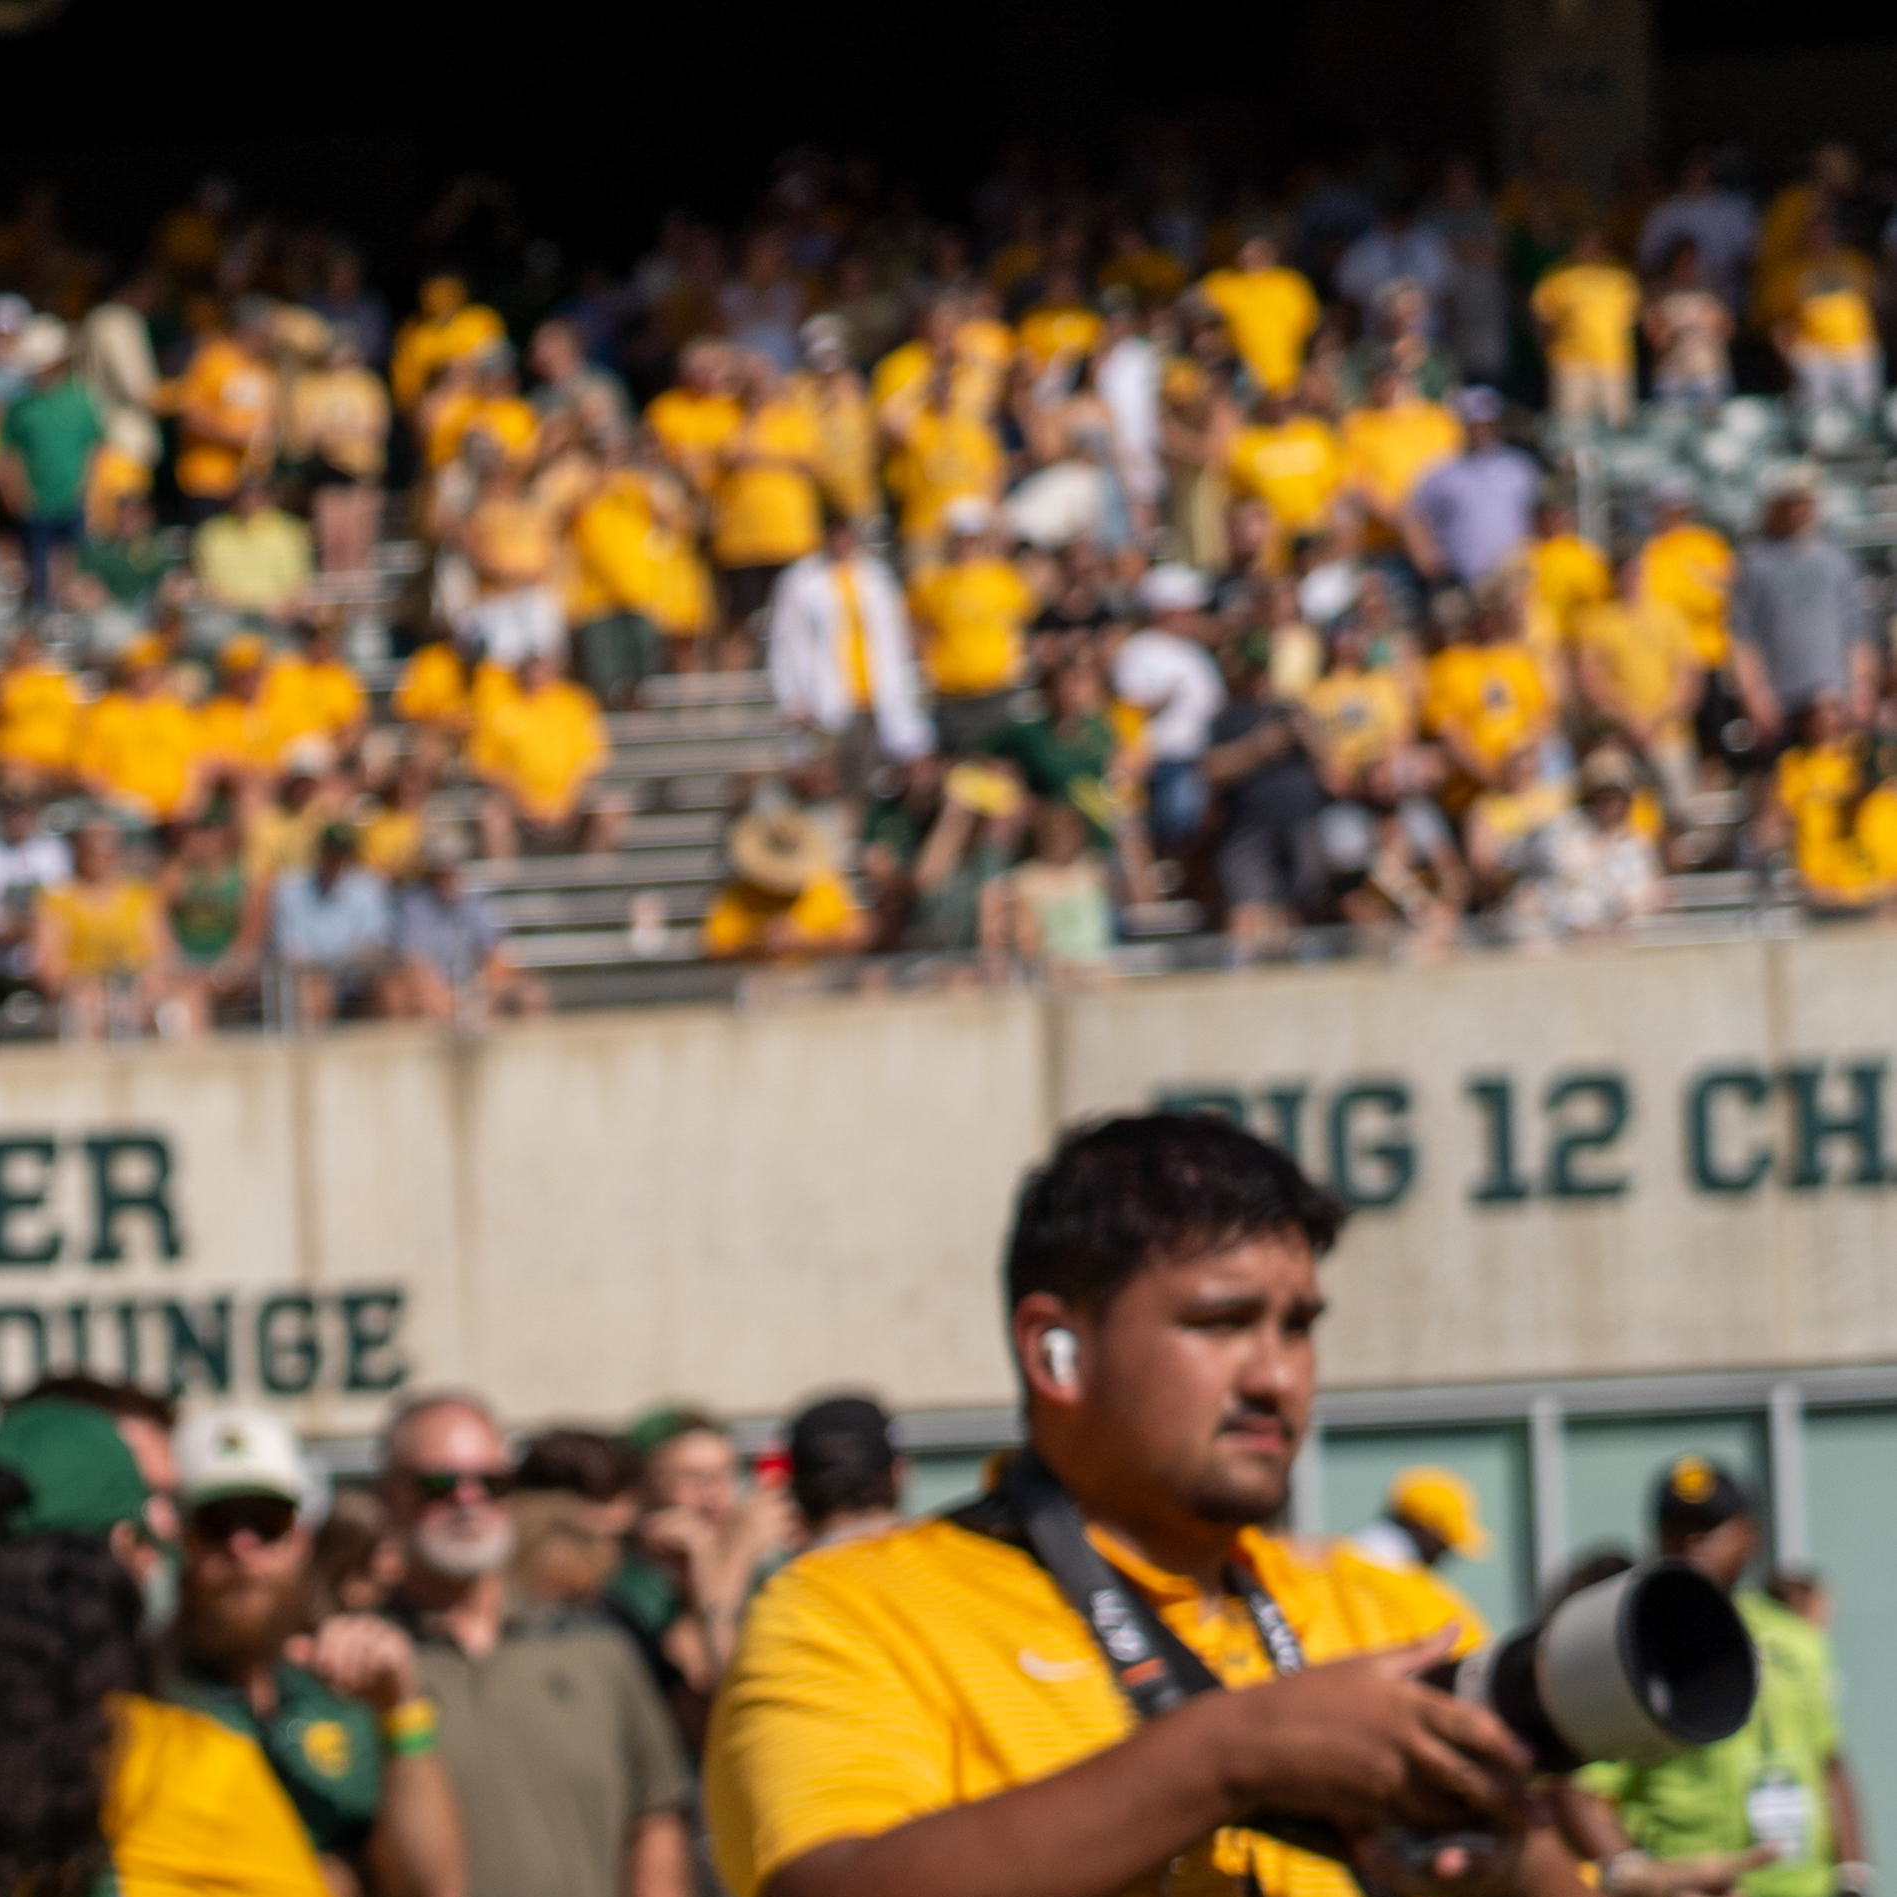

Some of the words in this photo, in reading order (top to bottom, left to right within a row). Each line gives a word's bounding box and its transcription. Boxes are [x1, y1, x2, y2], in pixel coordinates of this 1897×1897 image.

[1154, 1078, 1420, 1205] IG
[1468, 1066, 1633, 1202] 12
[1686, 1048, 1897, 1193] CH
